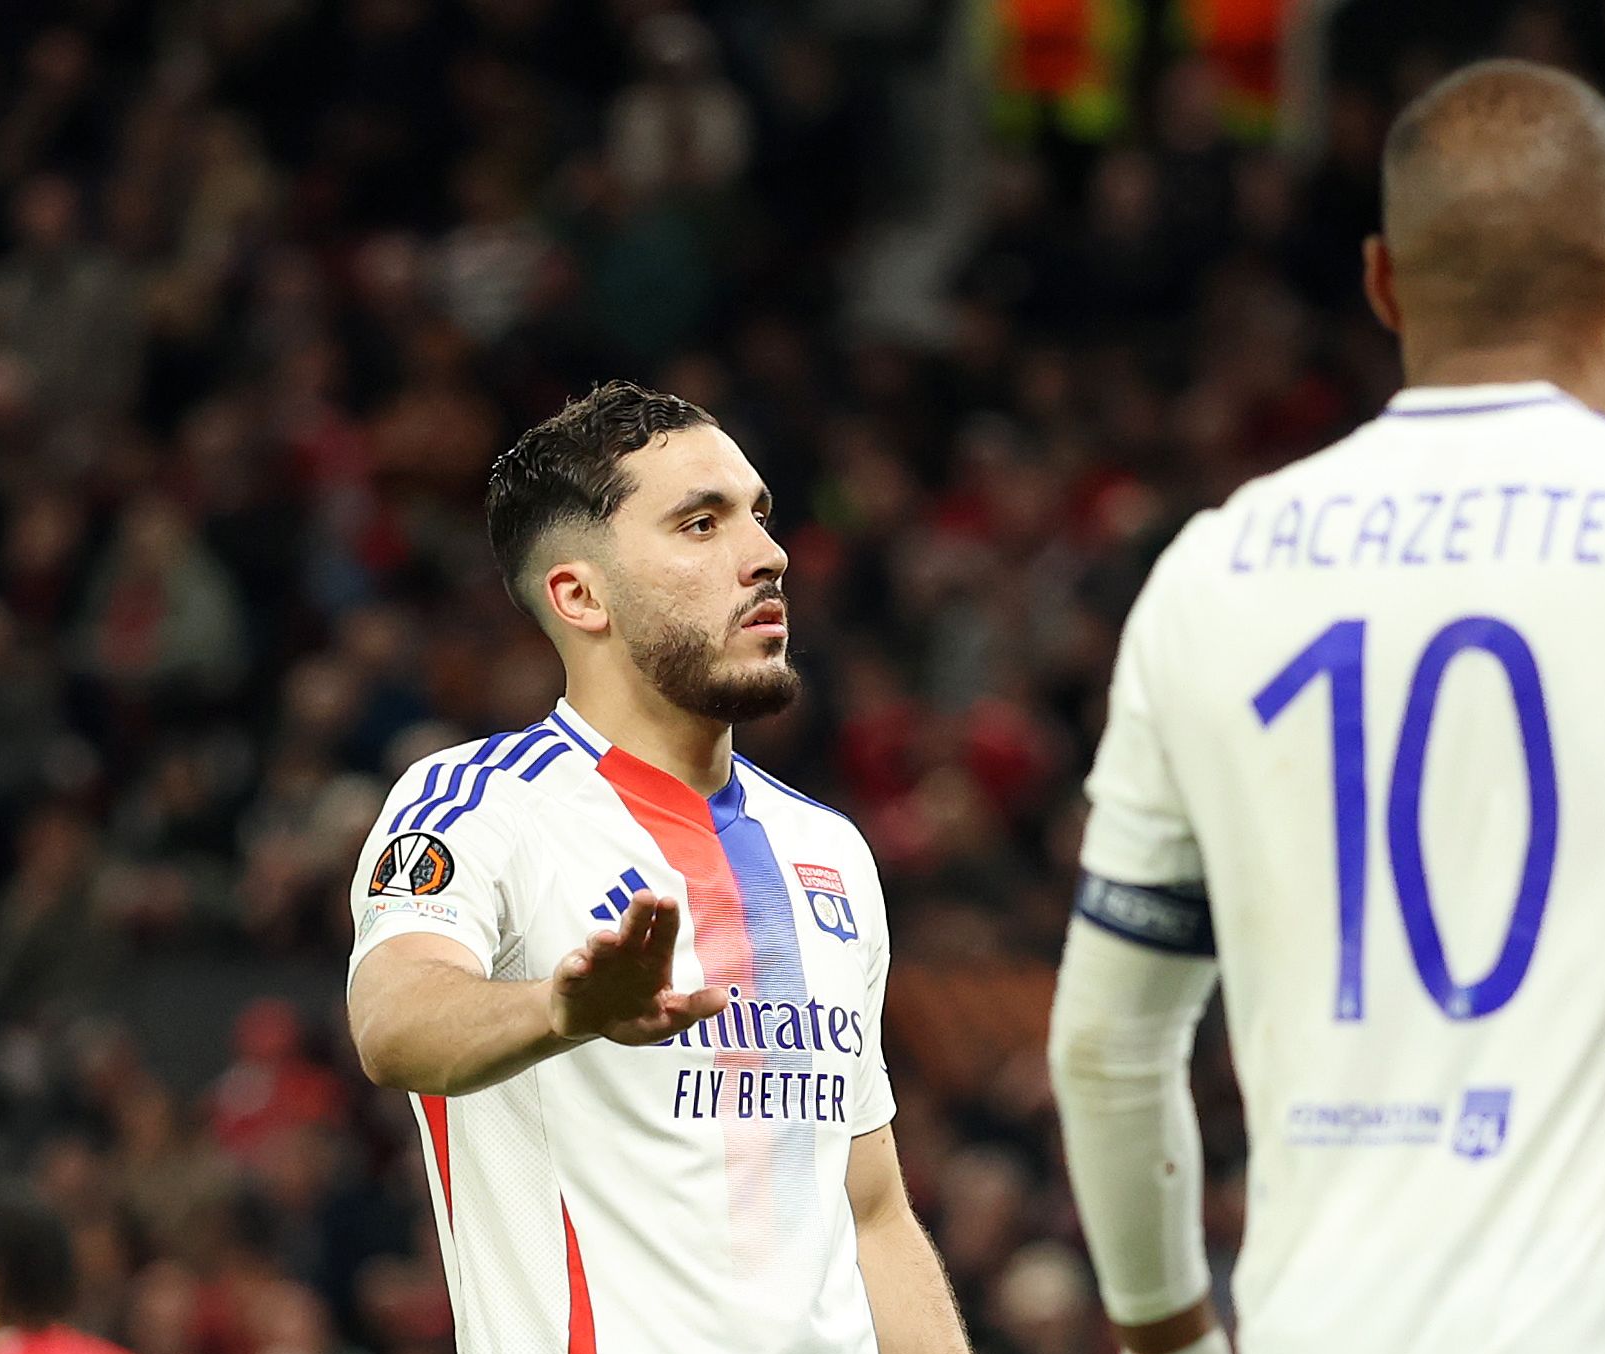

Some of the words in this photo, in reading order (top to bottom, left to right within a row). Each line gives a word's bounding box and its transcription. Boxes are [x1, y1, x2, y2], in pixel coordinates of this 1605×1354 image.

[1251, 615, 1559, 1021] 10
[652, 986, 863, 1058] mirates
[673, 1070, 724, 1118] FLY
[738, 1071, 846, 1123] BETTER
